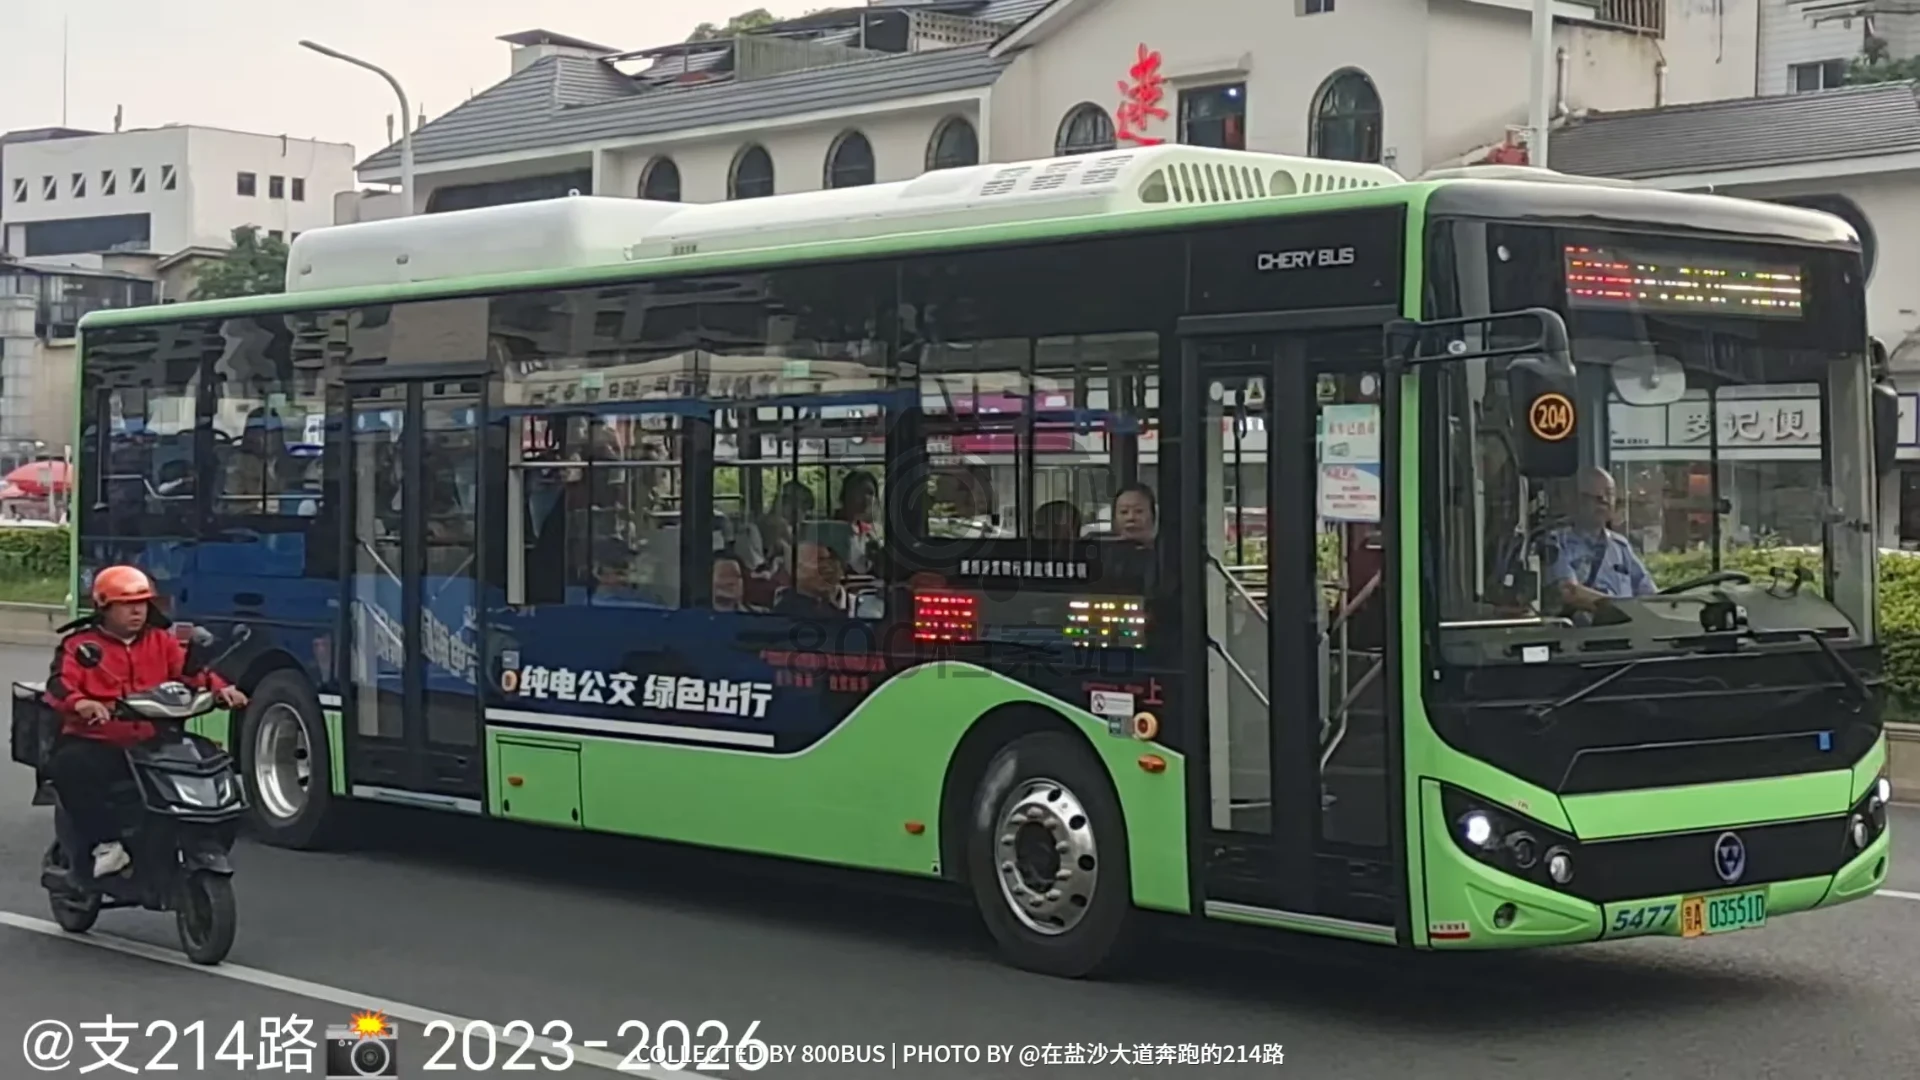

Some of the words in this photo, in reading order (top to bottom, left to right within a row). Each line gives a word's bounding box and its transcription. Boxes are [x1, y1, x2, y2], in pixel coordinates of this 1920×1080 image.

[1258, 250, 1316, 270] CHERY
[1318, 247, 1355, 266] BUS
[1538, 404, 1567, 429] 204
[519, 665, 639, 706] 纯电公交
[642, 674, 773, 718] 绿色出行
[1612, 905, 1677, 931] 5477
